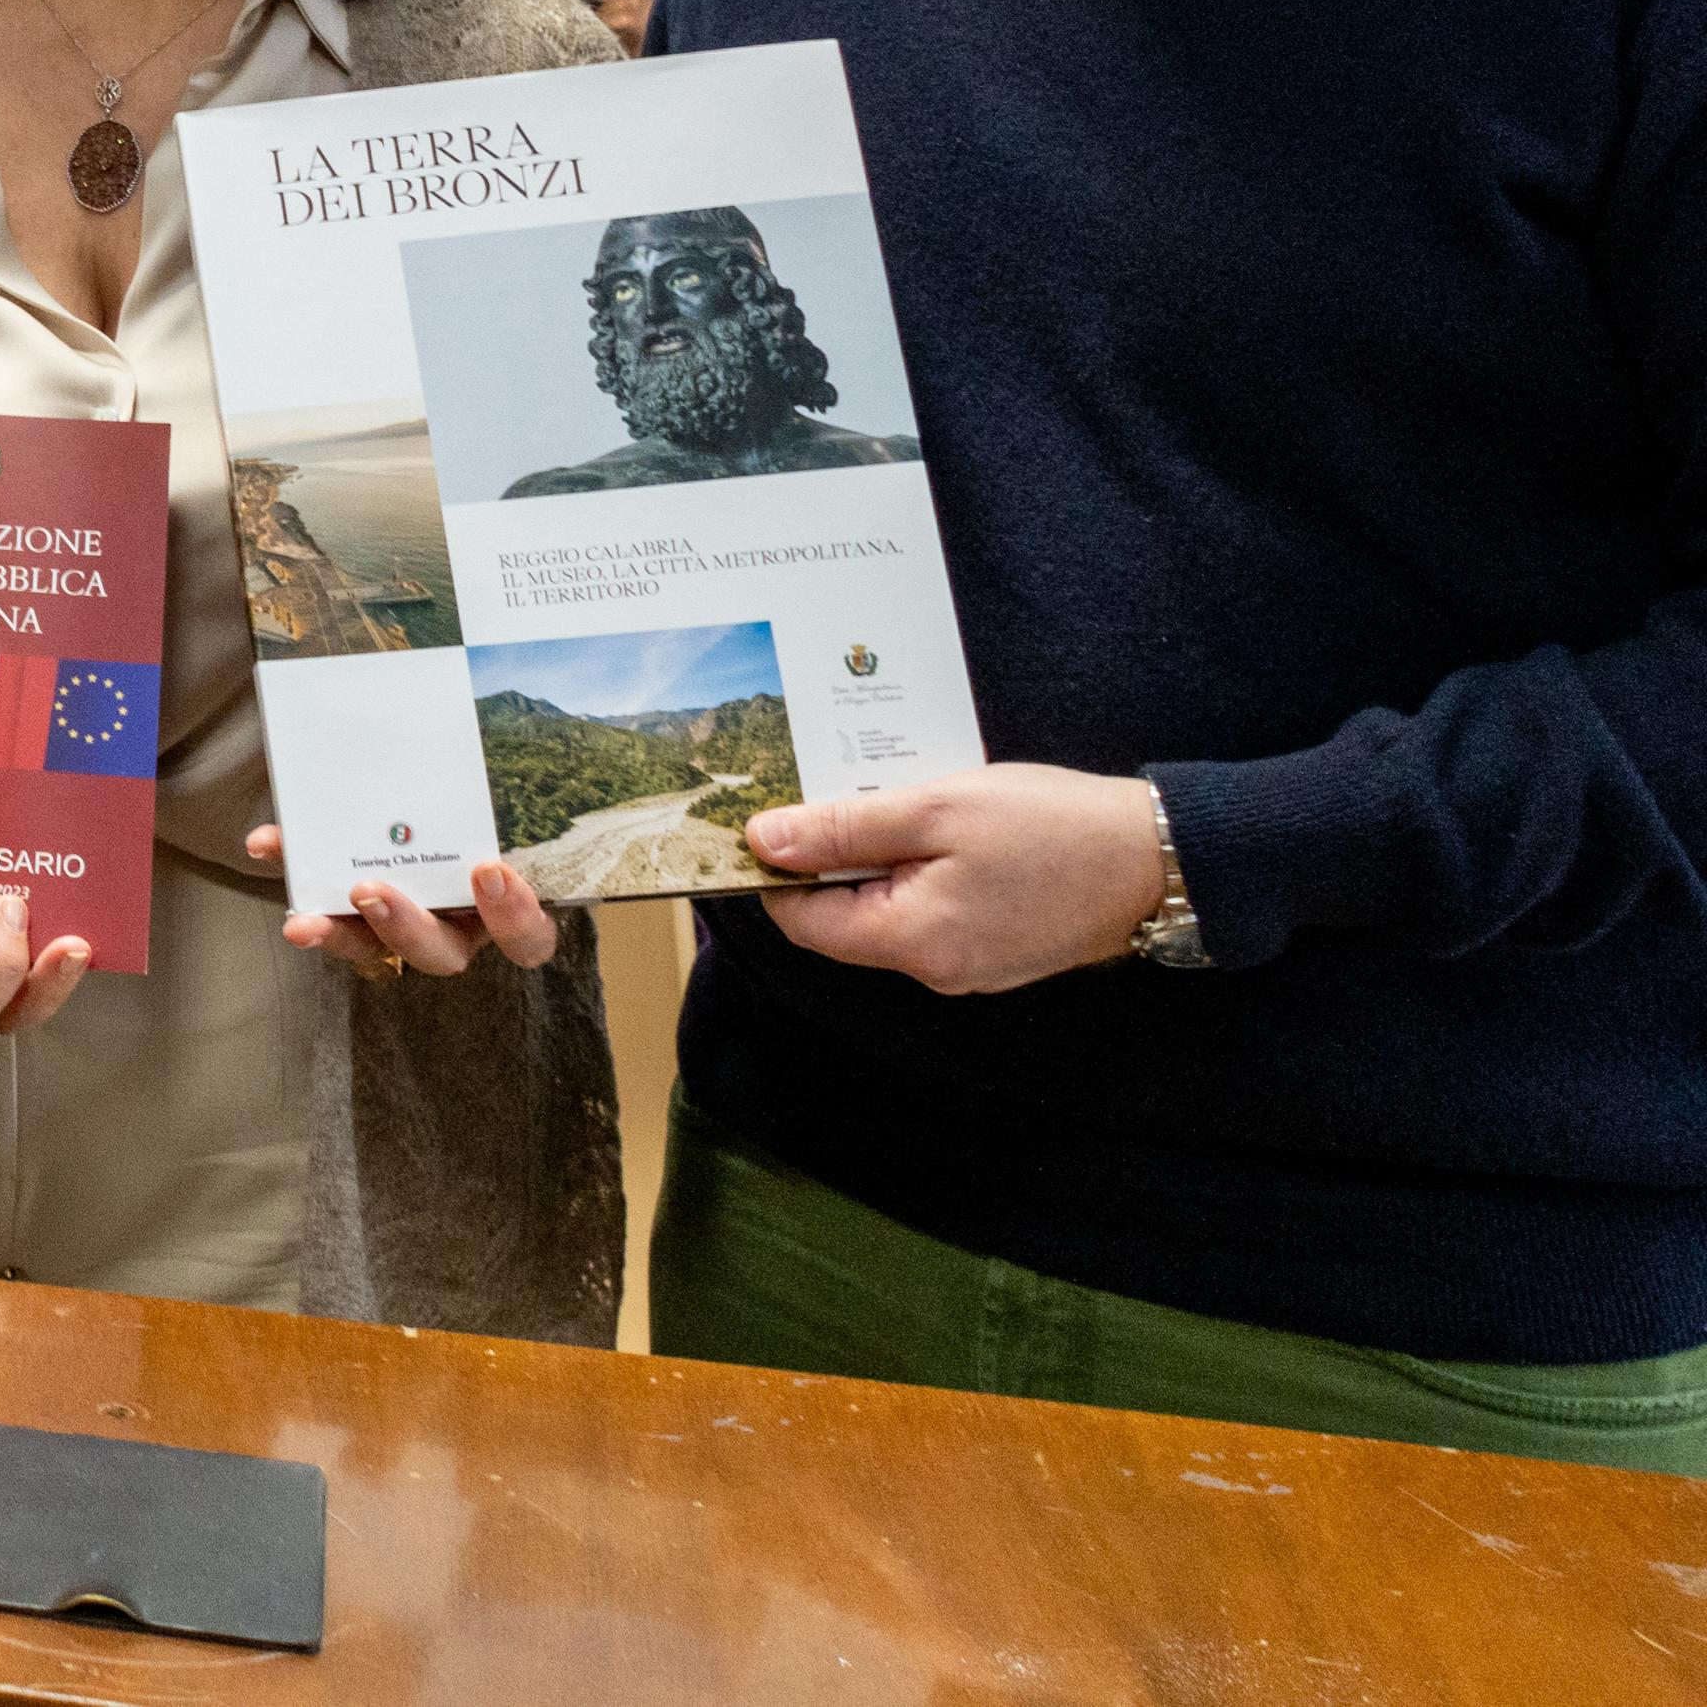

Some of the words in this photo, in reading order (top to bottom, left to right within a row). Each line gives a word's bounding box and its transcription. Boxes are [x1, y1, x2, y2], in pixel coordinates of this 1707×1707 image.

[267, 144, 340, 185] LA
[351, 122, 542, 175] TERRA
[275, 182, 370, 228] DEI
[385, 156, 589, 216] BRONZI
[498, 546, 580, 570] REGGIO
[502, 572, 523, 589] IL
[612, 562, 640, 580] LA
[505, 591, 526, 608] IL
[531, 579, 660, 606] TERRITORIO
[351, 856, 391, 869] Touring
[393, 854, 418, 866] Club
[421, 851, 461, 863] Italiano
